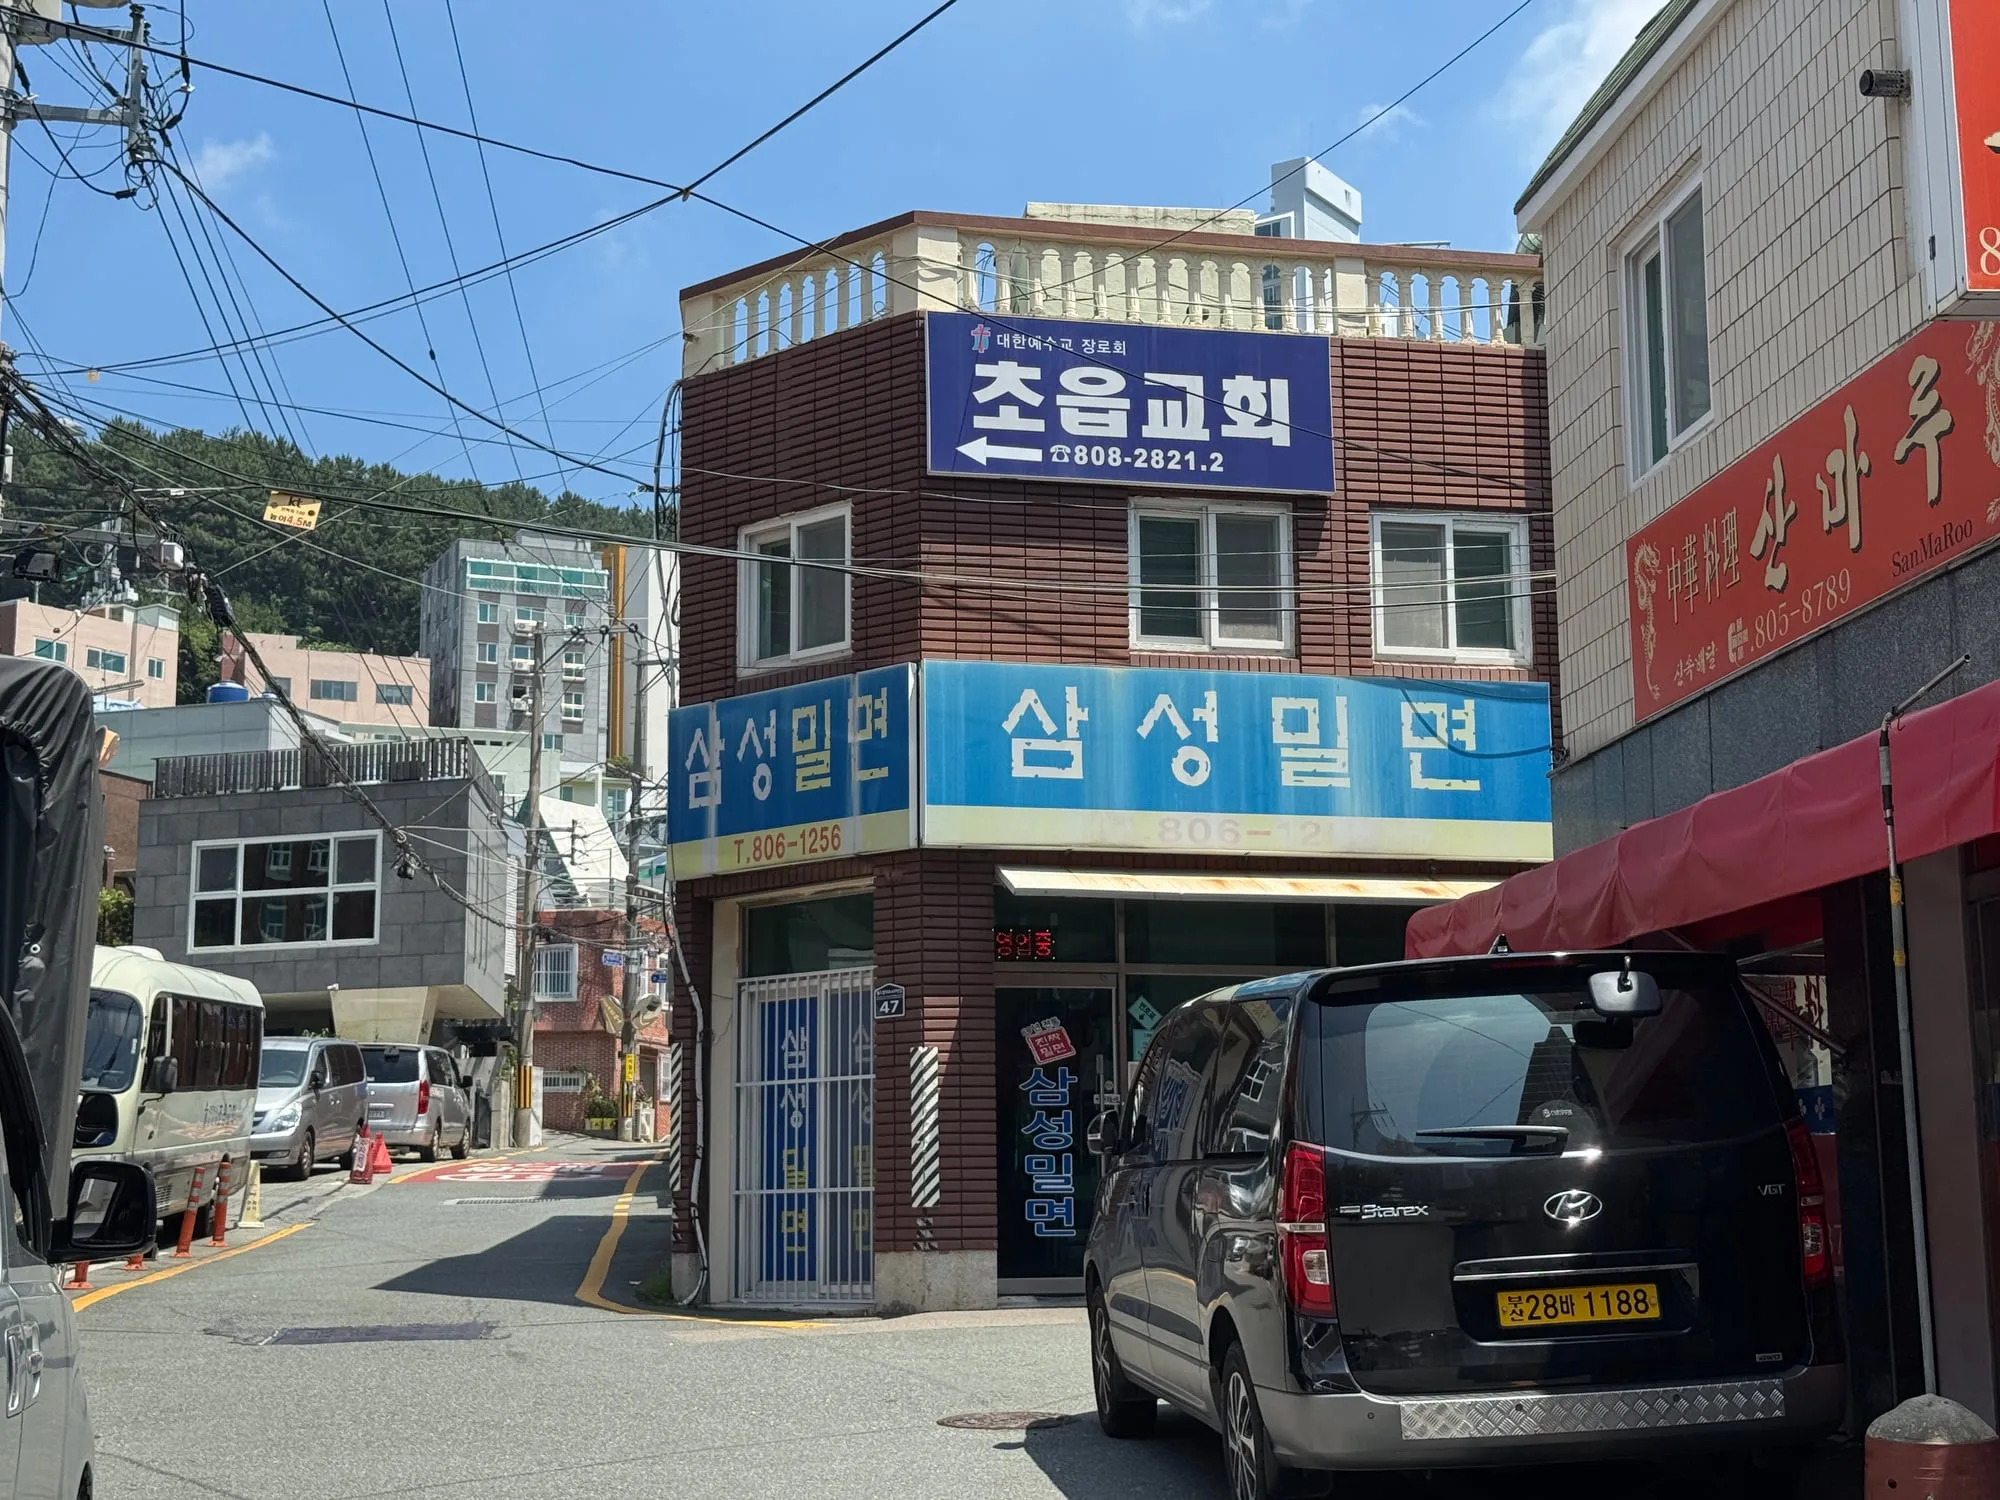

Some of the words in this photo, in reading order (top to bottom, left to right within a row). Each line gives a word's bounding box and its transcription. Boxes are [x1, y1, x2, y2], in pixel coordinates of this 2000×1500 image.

[996, 332, 1074, 353] 대한예수교
[1081, 336, 1127, 356] 장로회
[972, 360, 1292, 447] 초읍교회
[1073, 444, 1225, 473] 808-2821.2
[289, 495, 304, 508] kt
[1891, 518, 1974, 578] SanMaRoo
[1667, 506, 1741, 625] 中華料理
[1001, 685, 1482, 792] 삼성밀면
[995, 931, 1052, 957] 영업중
[879, 999, 900, 1014] 47
[1018, 1066, 1079, 1237] 삼성밀면
[1757, 1183, 1786, 1196] VGT
[1361, 1203, 1430, 1219] Starex
[1507, 1296, 1525, 1322] 부산
[1583, 1288, 1650, 1317] 1188
